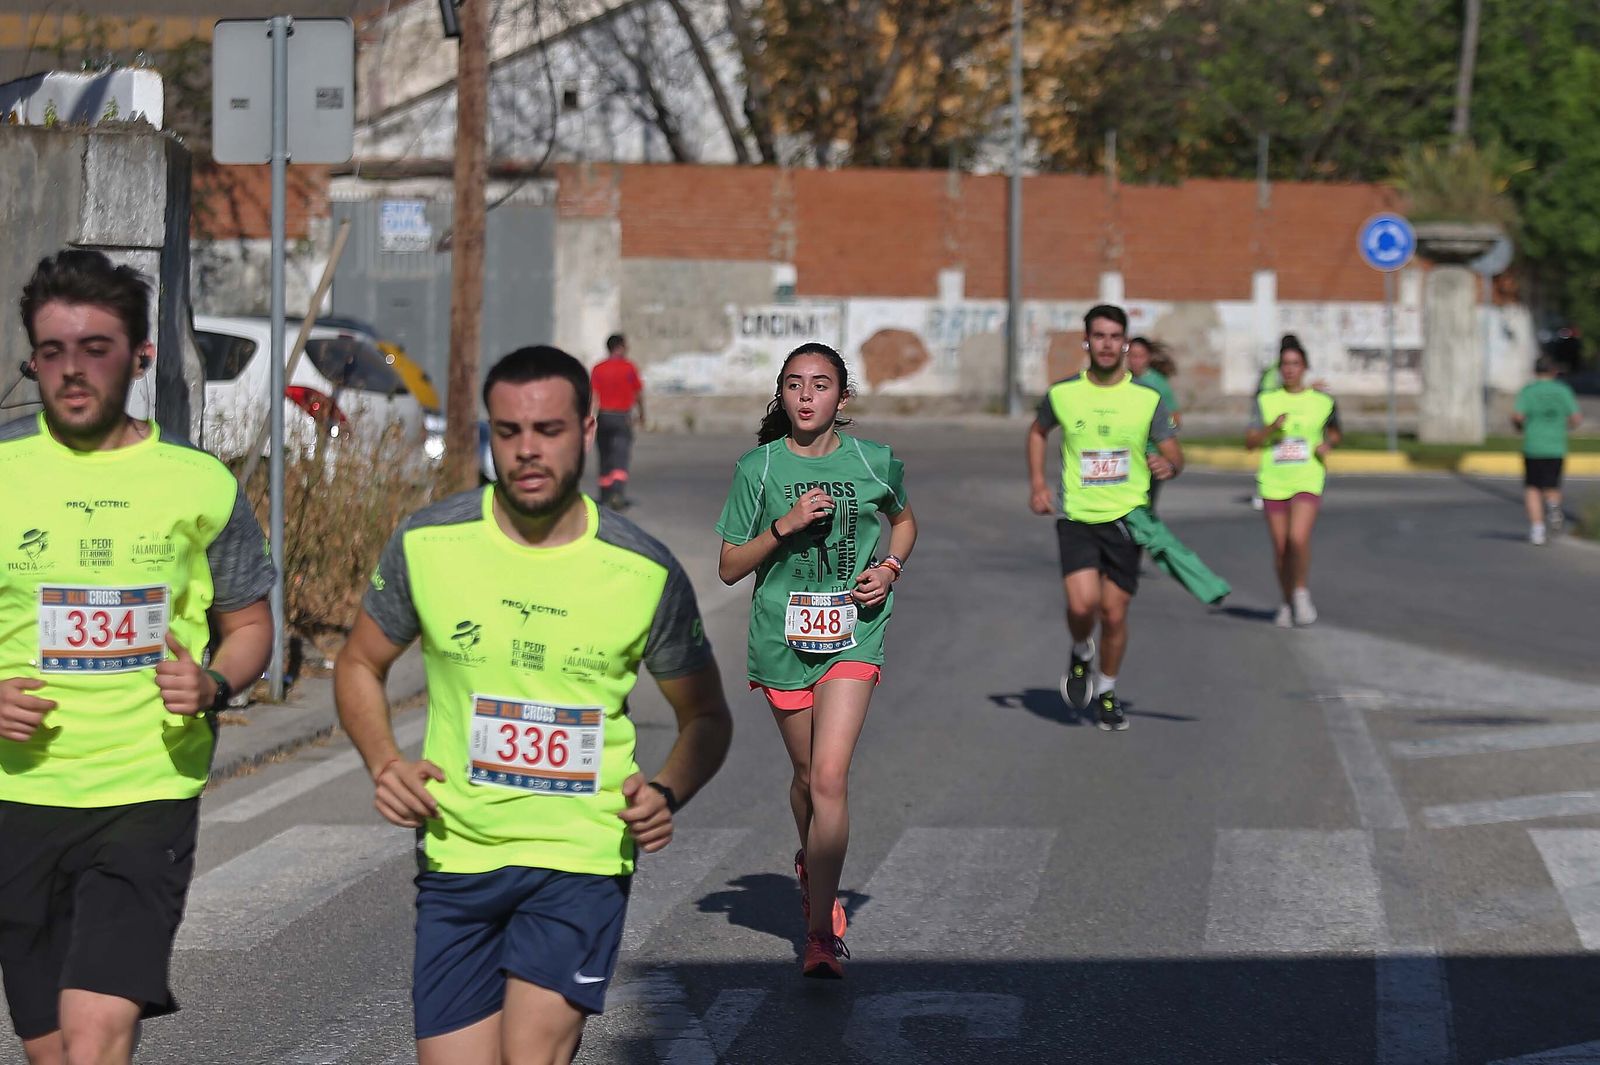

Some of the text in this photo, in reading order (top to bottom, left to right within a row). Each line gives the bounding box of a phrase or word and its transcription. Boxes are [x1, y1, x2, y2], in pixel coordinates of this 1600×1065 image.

[837, 539, 848, 582] MARIA
[89, 590, 122, 605] CROSS
[811, 595, 832, 606] CROSS
[66, 609, 139, 648] 334
[799, 608, 842, 635] 348
[522, 704, 556, 723] CROSS
[497, 723, 570, 768] 336
